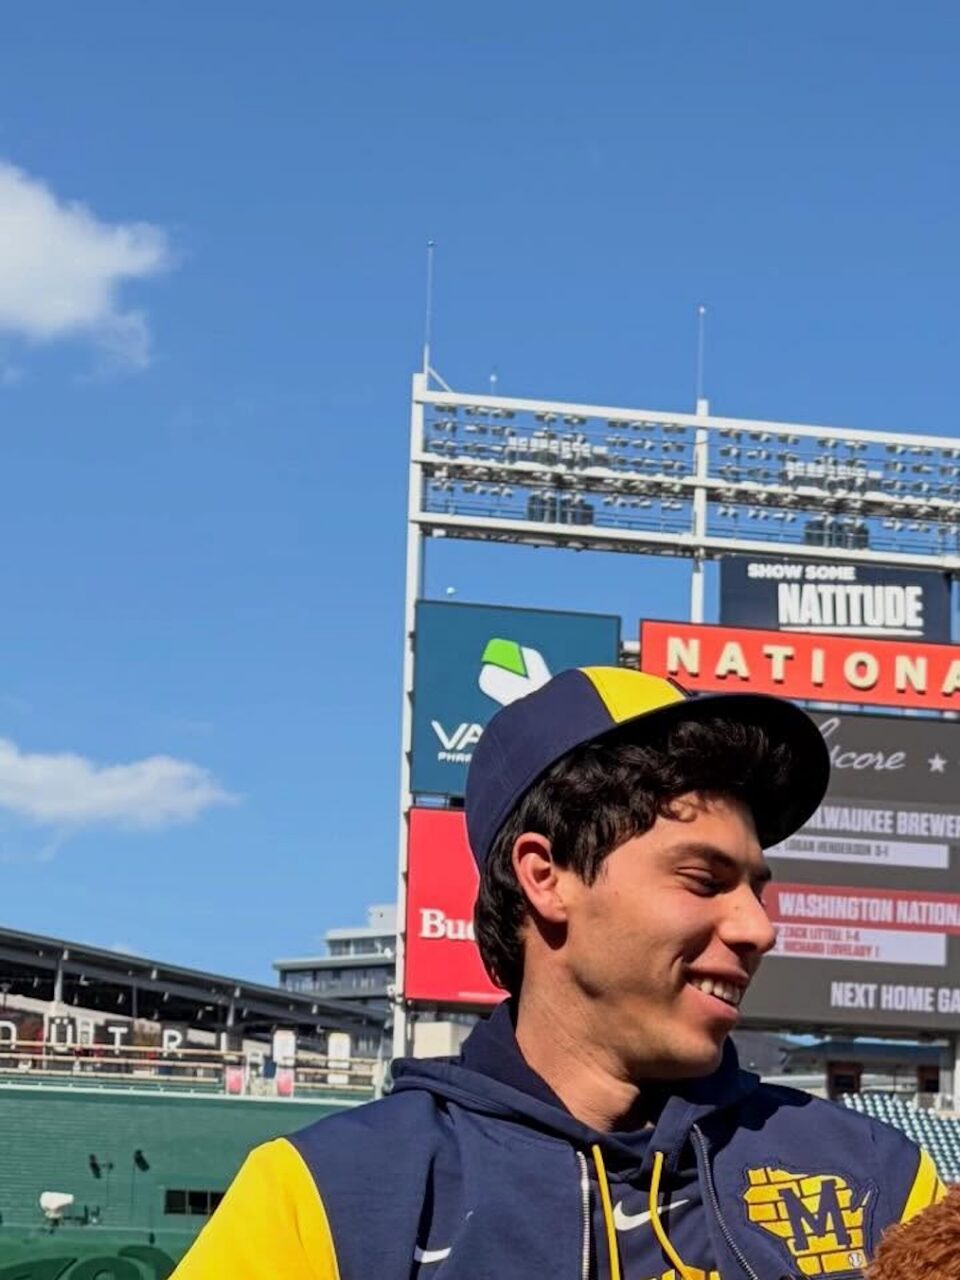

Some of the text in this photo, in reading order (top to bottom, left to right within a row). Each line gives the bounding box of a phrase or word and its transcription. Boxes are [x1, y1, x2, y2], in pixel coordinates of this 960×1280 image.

[748, 563, 856, 581] SHOW SOME
[778, 583, 924, 627] NATITUDE
[801, 806, 894, 833] ILWAUKEE
[778, 892, 893, 923] WASHINGTON
[831, 981, 878, 1007] NEXT
[881, 985, 935, 1012] HOME
[777, 1178, 851, 1251] M
